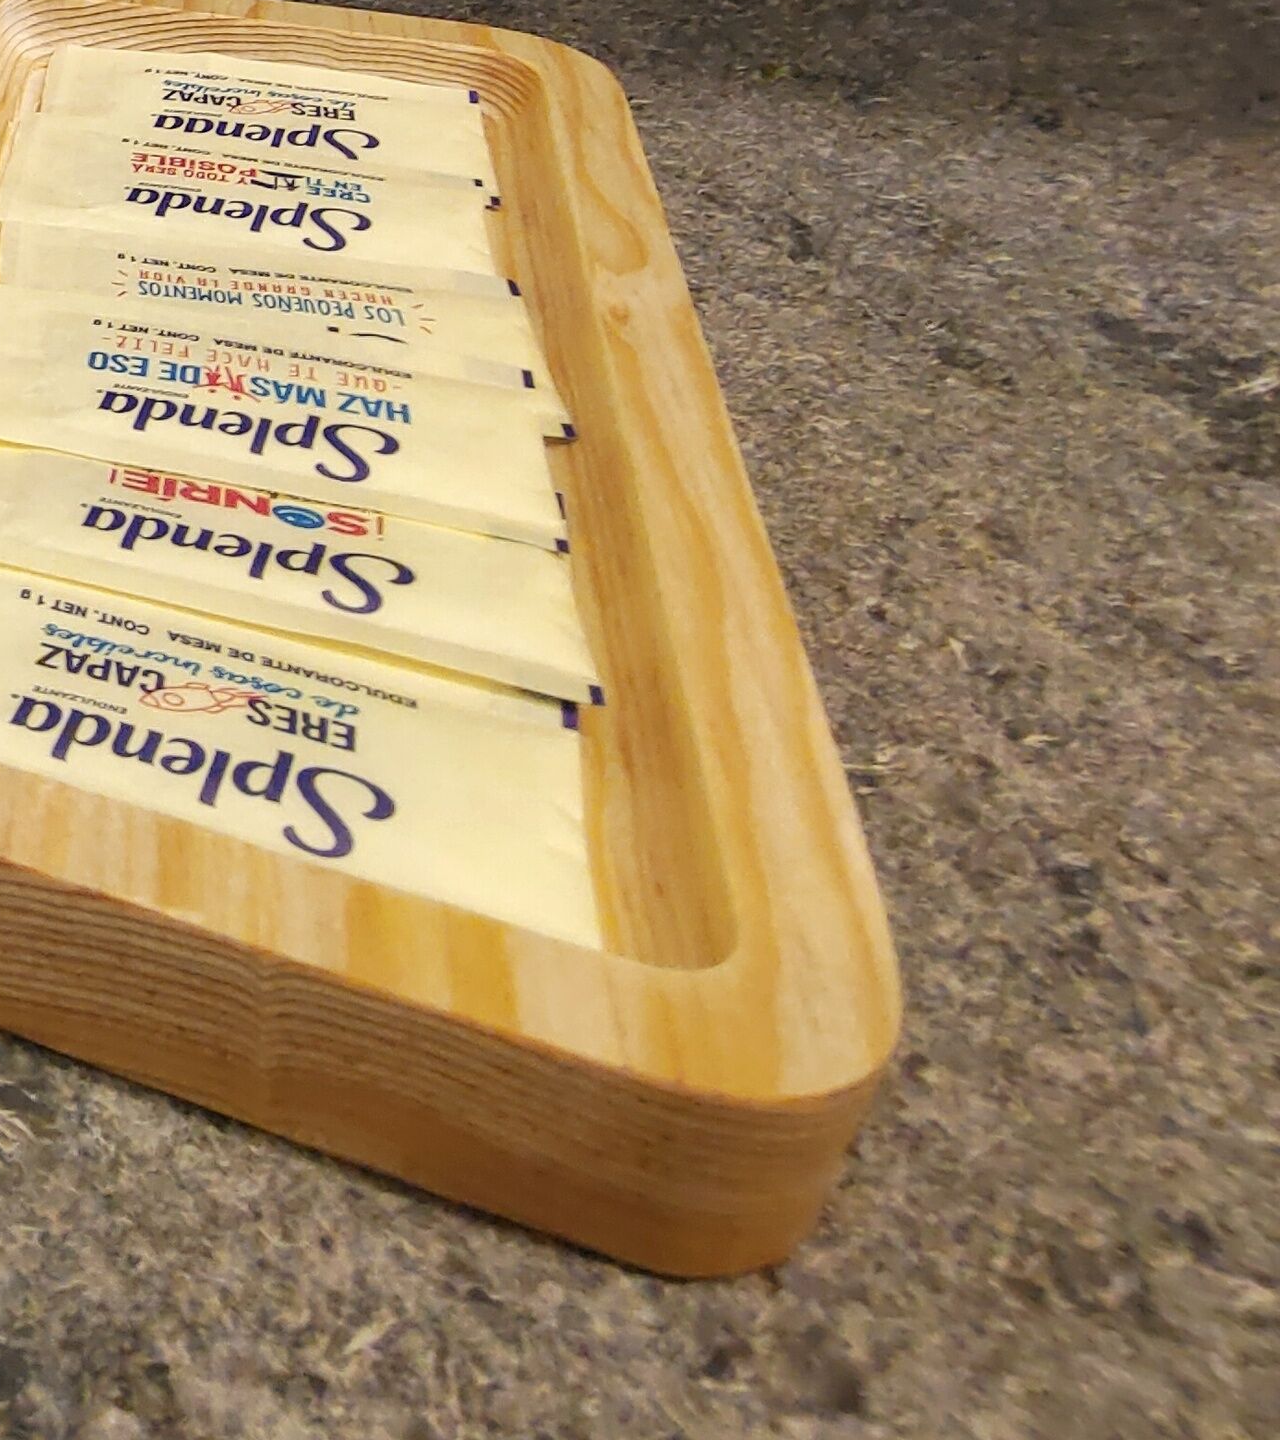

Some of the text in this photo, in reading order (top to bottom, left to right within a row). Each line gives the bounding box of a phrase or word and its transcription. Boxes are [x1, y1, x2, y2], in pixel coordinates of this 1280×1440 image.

[161, 87, 357, 122] ERES CAPAZ
[130, 162, 178, 180] SERÁ
[183, 168, 238, 185] TODO
[333, 177, 363, 191] EN
[306, 182, 372, 205] CREE
[124, 186, 373, 253] Splenda
[137, 280, 407, 327] LOS PEQUEÑOS MOMENTOS
[229, 279, 312, 299] GRANDE
[117, 319, 150, 334] NET
[203, 346, 271, 376] HACE
[287, 362, 319, 382] TE
[86, 350, 413, 427] HAZ MÁS DE ESO
[95, 389, 401, 484] Splenda
[80, 504, 416, 616] Splenda
[51, 597, 90, 619] NET
[93, 610, 152, 637] CONT.
[167, 628, 223, 656] MESA
[228, 646, 256, 662] DE
[34, 641, 358, 753] ERES CAPAZ
[208, 664, 304, 701] cosas
[260, 655, 418, 710] EDULCORANTE
[33, 684, 129, 714] ENDULZANTE
[312, 694, 362, 718] de
[8, 693, 396, 860] Splenda
